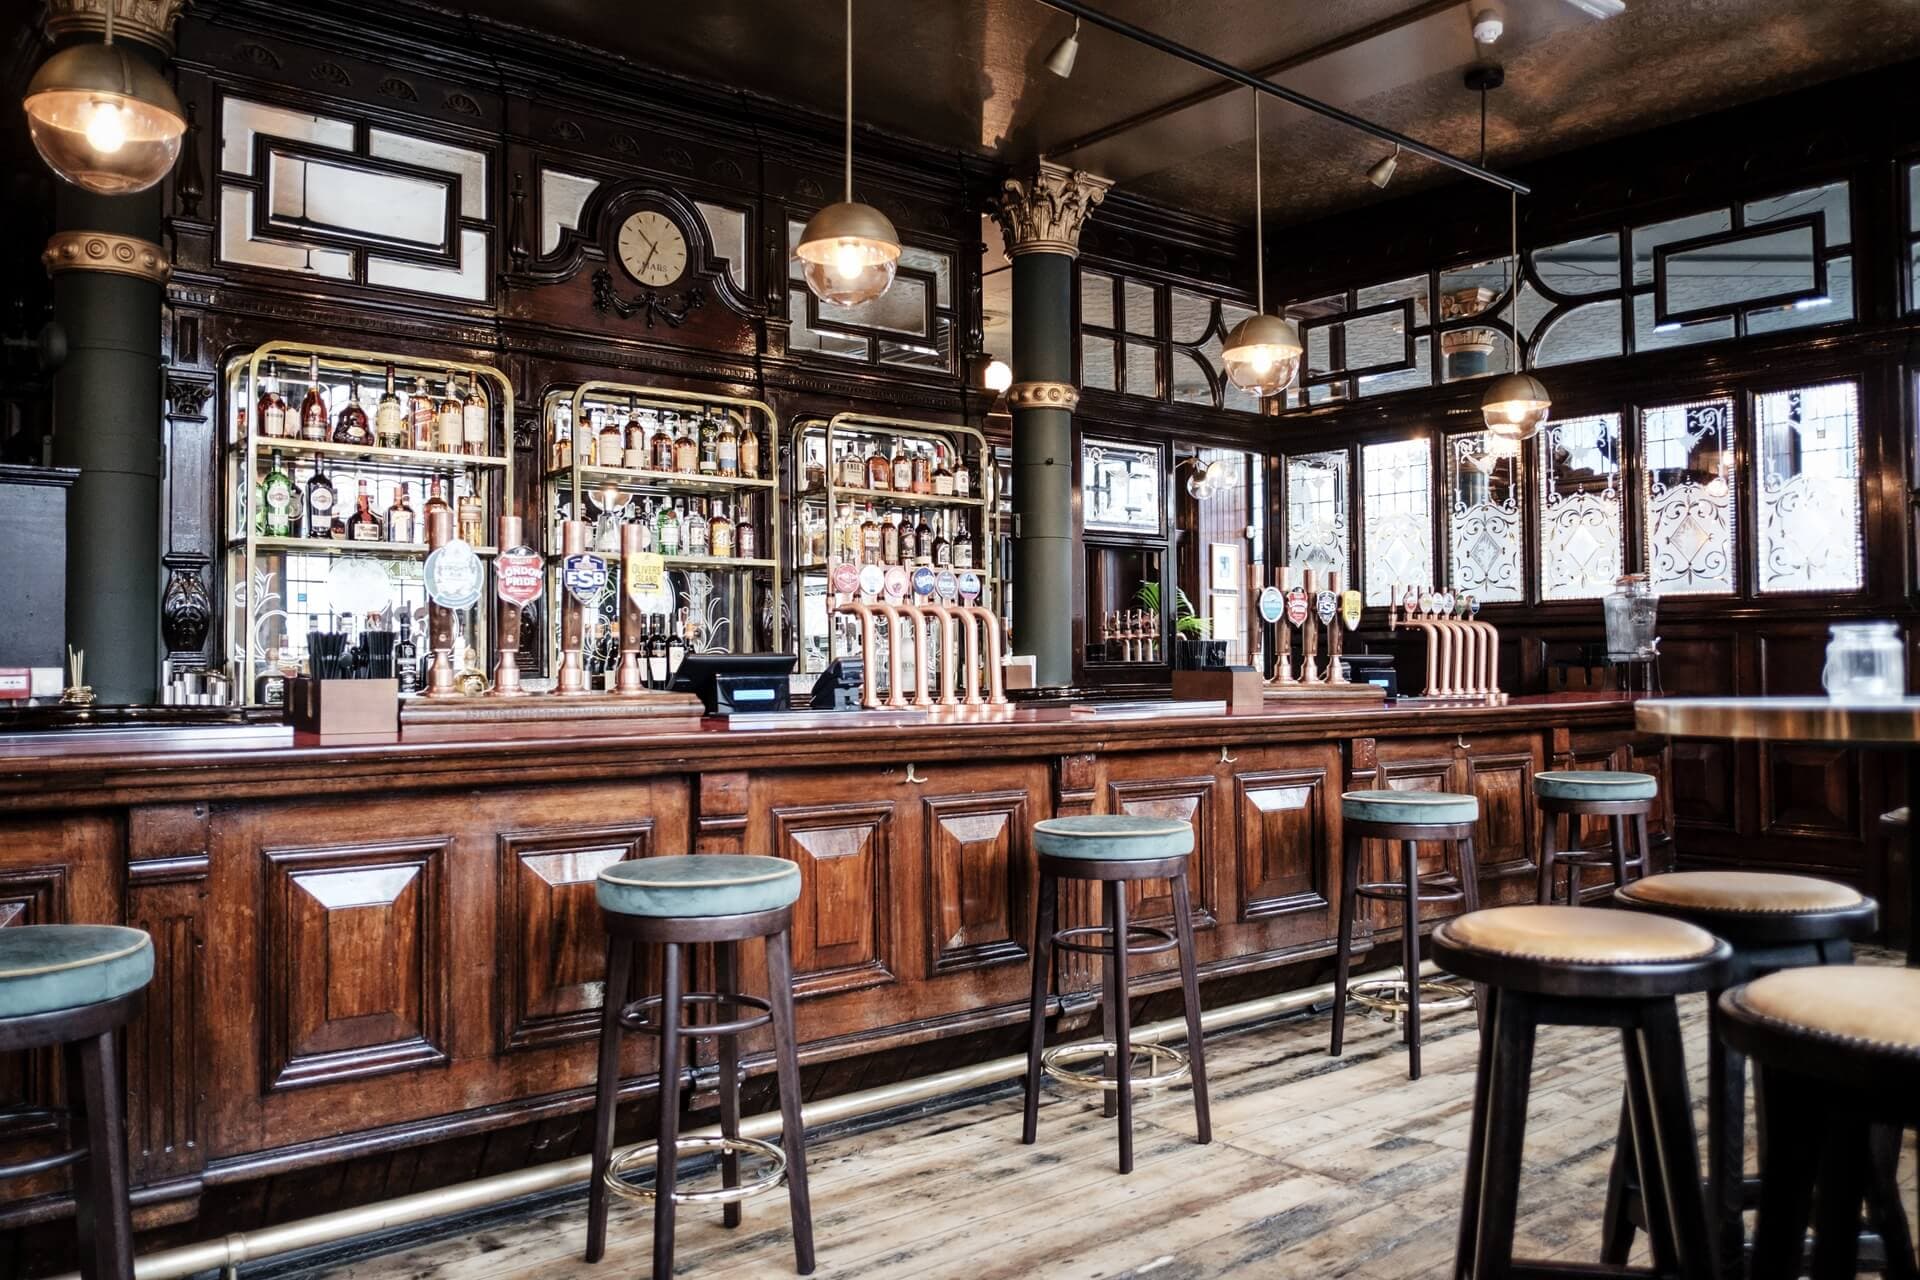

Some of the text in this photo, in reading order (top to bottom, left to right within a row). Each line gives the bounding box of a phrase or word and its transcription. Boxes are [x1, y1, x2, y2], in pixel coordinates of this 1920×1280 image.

[497, 566, 542, 579] LONDON
[505, 576, 537, 586] PRIDE
[567, 570, 604, 587] ESB
[1319, 602, 1336, 612] ESB
